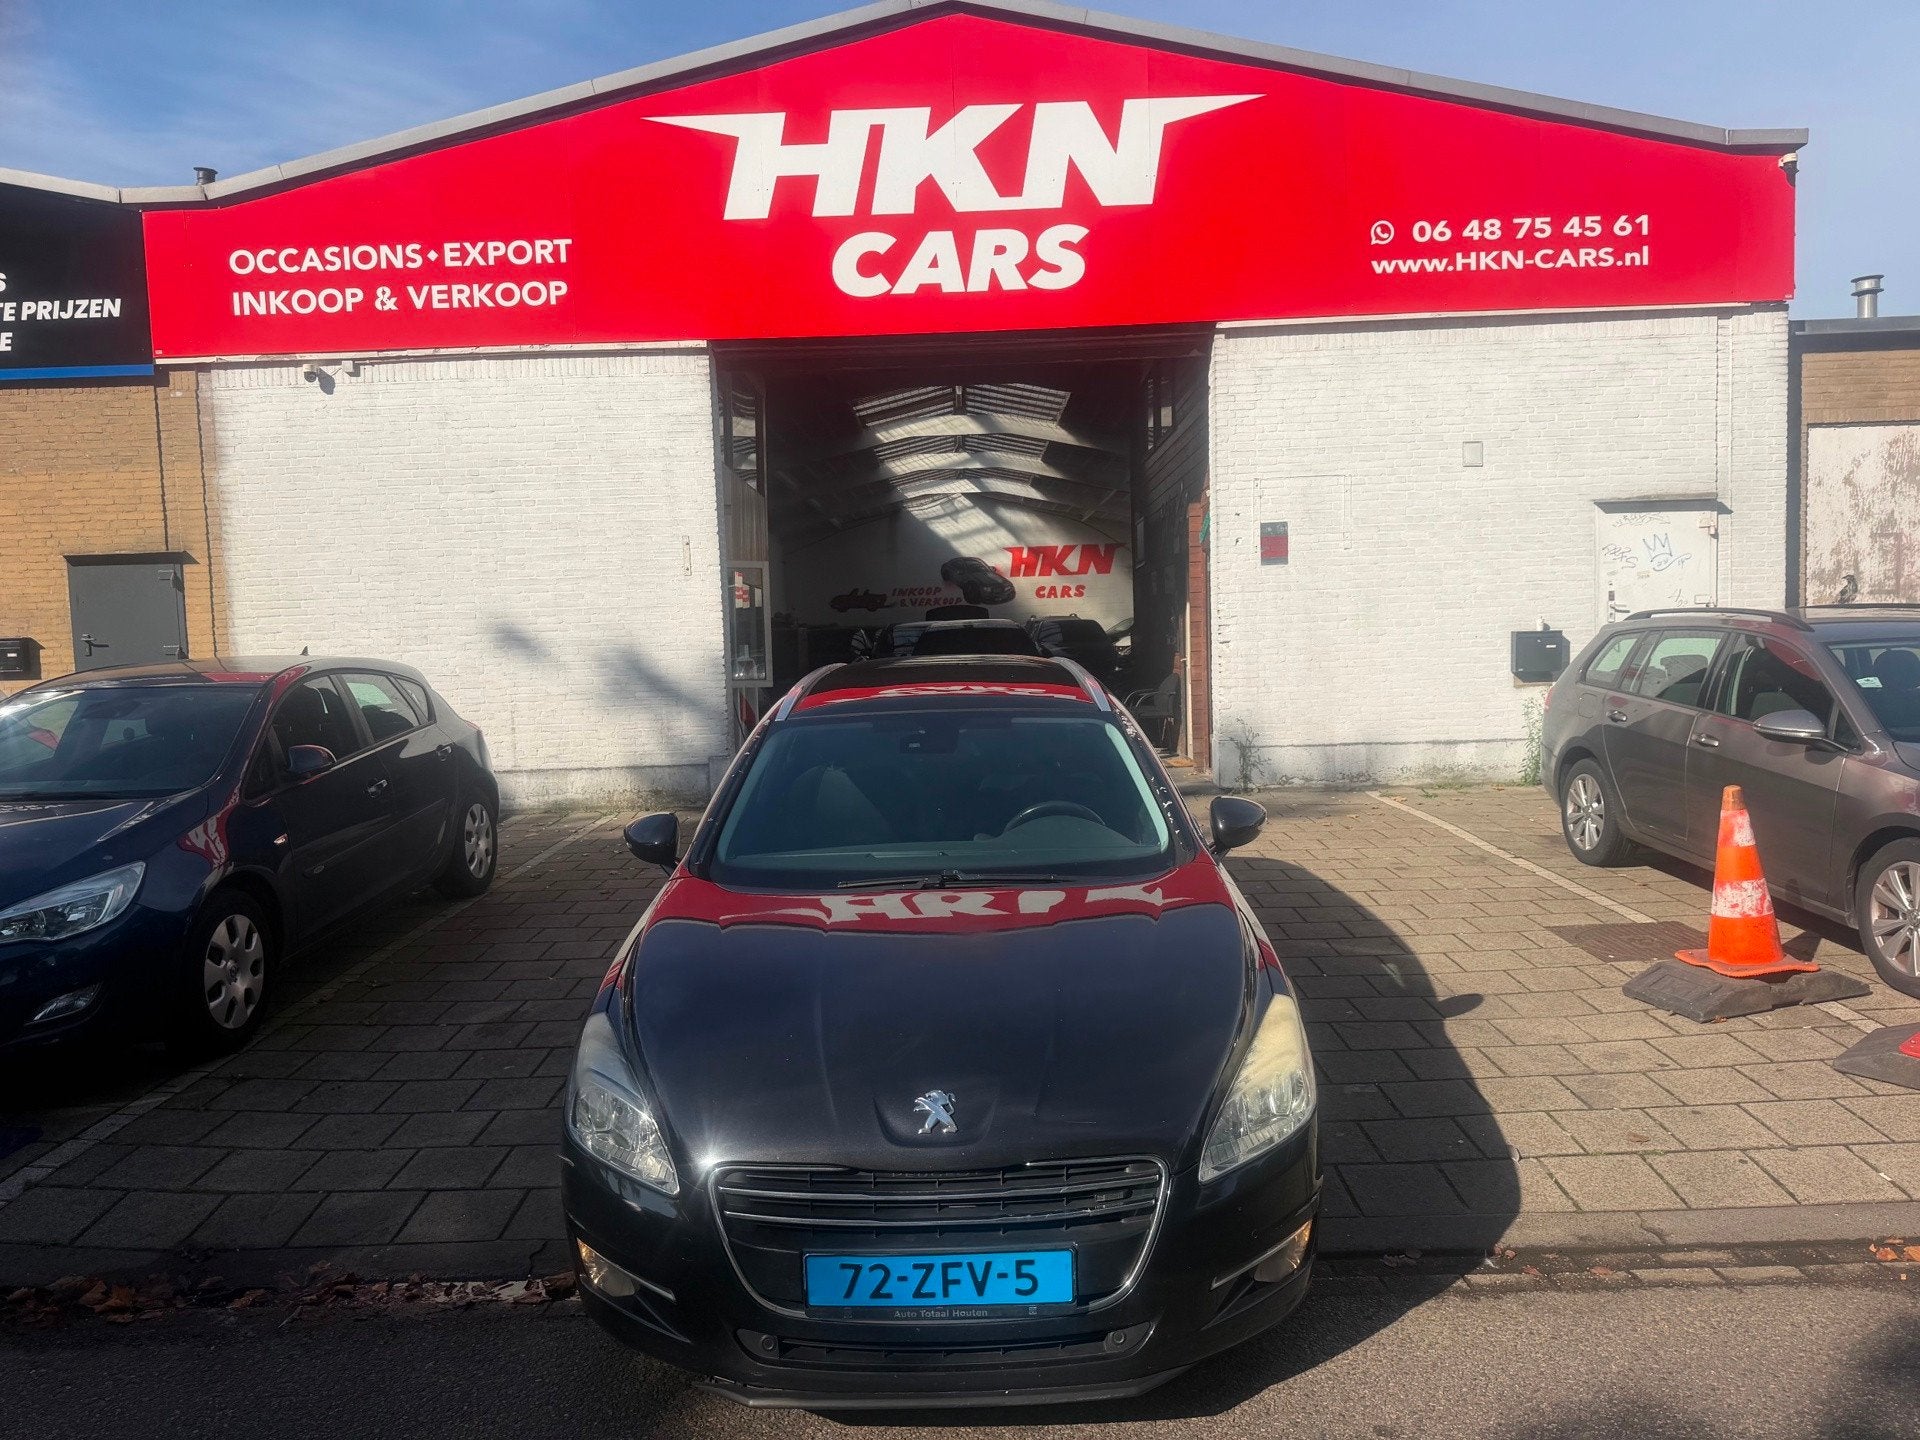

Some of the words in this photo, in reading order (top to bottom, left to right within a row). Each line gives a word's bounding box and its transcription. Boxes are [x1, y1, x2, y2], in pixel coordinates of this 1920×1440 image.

[641, 94, 1267, 220] HKN
[1412, 220, 1452, 242] 06
[1462, 218, 1502, 240] 48
[1512, 217, 1552, 239] 75
[1563, 216, 1602, 237] 45
[1613, 214, 1649, 236] 61
[229, 243, 423, 275] OCCASIONS
[443, 238, 573, 267] EXPORT
[831, 223, 1090, 298] CARS
[1371, 245, 1649, 274] www.HKN-CARS.nl
[21, 298, 121, 320] PRIJZEN
[233, 287, 364, 316] INKOOP
[374, 286, 398, 311] &
[406, 280, 568, 310] VERKOOP
[1002, 543, 1127, 577] HKN
[892, 586, 942, 597] INKOOP
[910, 597, 964, 607] VERKOOP
[1035, 584, 1086, 598] CARS
[839, 1259, 1038, 1299] 72-ZFV-5
[893, 1309, 918, 1318] Auto
[920, 1308, 950, 1318] Totaal
[952, 1308, 988, 1317] Houten
